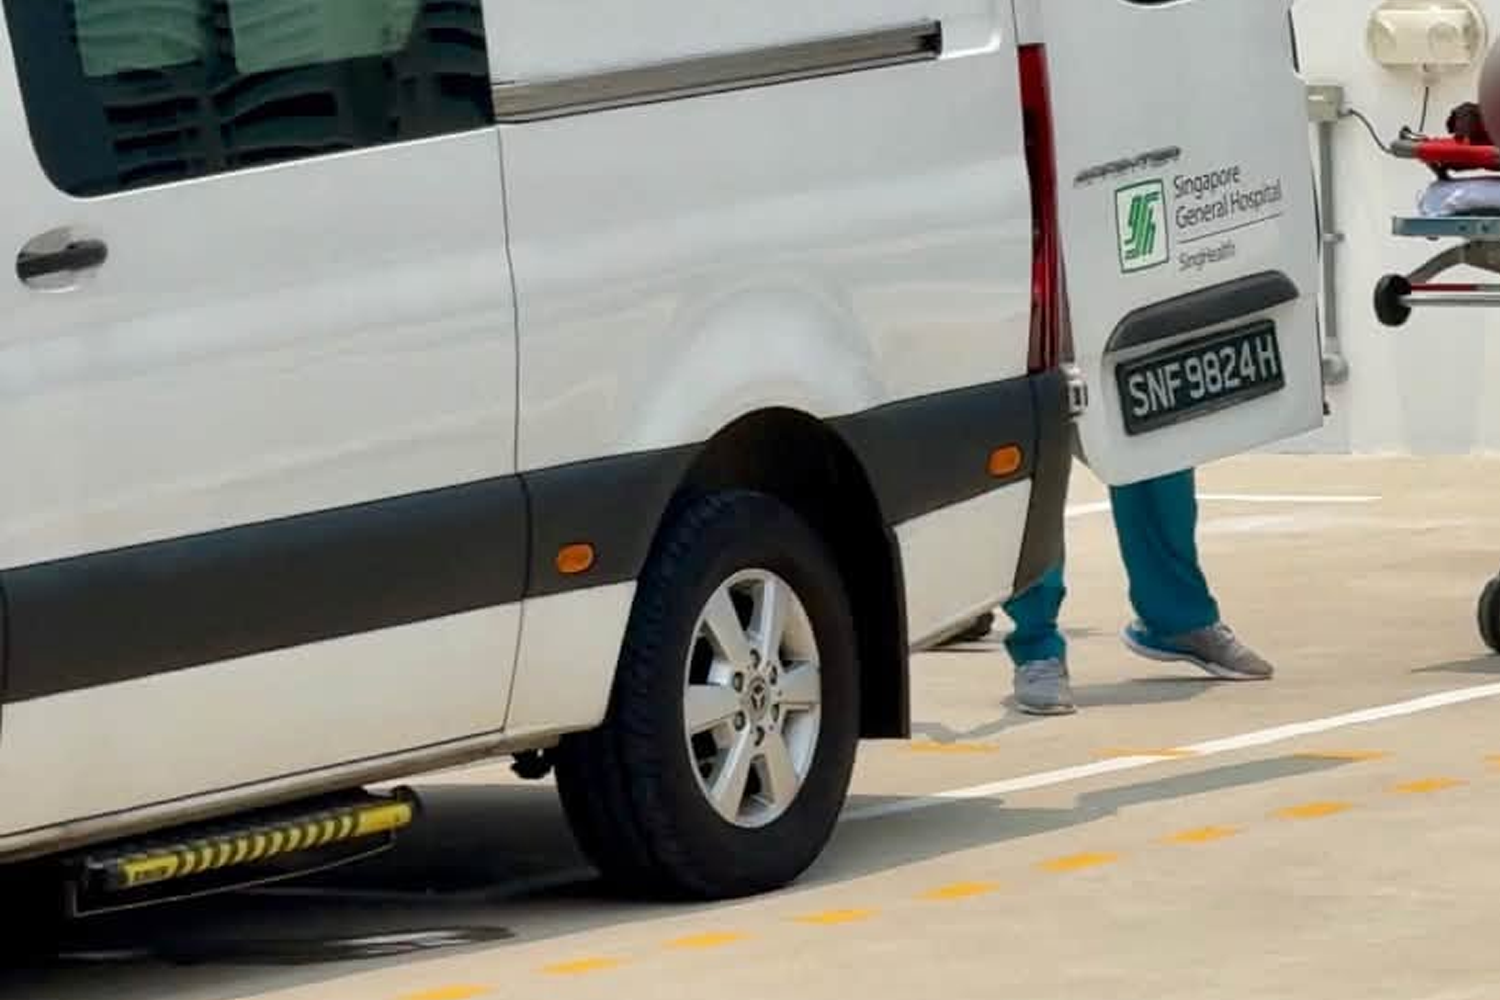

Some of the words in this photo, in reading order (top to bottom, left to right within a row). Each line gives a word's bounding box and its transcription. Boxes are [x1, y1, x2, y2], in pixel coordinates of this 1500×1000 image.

[1173, 165, 1240, 199] Singapore
[1176, 194, 1228, 228] General
[1230, 179, 1282, 218] Hospital
